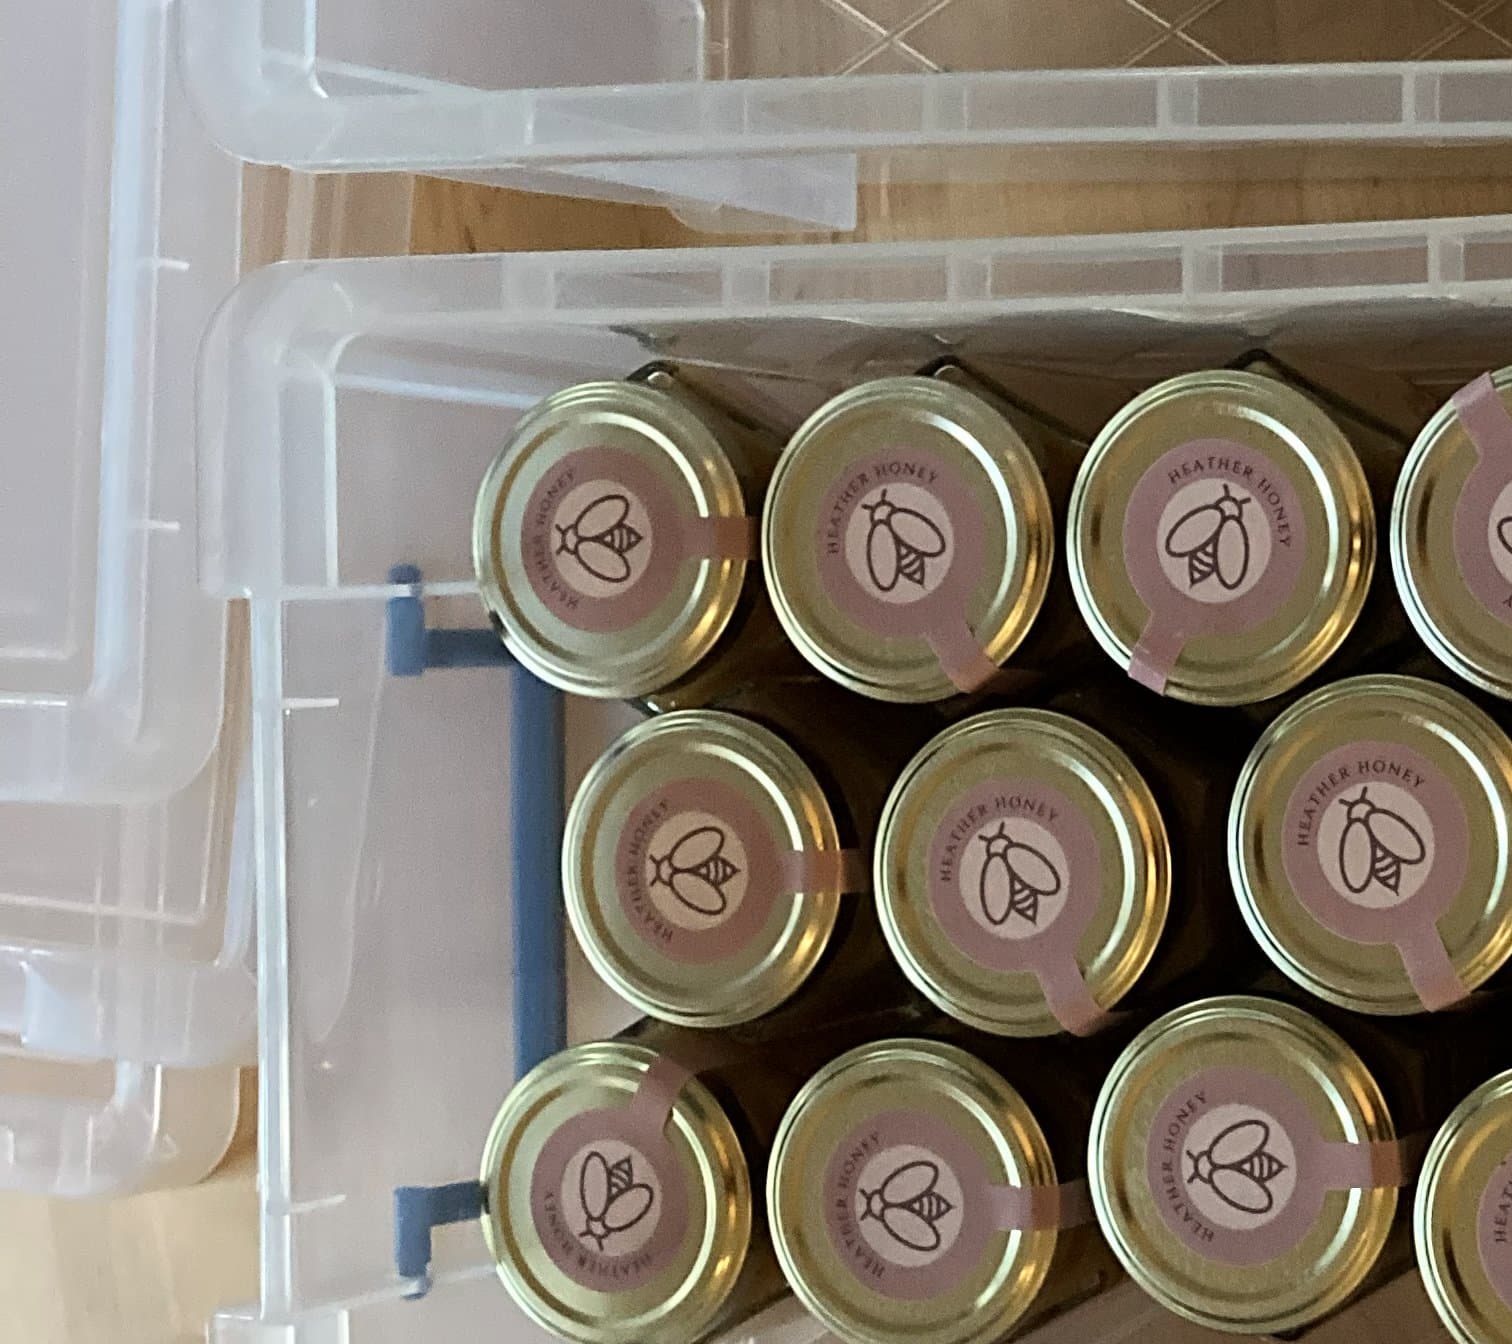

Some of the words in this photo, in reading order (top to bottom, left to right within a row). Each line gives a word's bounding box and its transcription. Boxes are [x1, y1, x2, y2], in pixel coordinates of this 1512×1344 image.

[826, 474, 870, 554] HEATHER
[875, 460, 938, 485] HONEY
[1169, 457, 1254, 484] HEATHER
[1257, 478, 1292, 548] HONEY
[940, 805, 988, 883] HEATHER
[993, 795, 1060, 824] HONEY
[1296, 766, 1351, 847] HEATHER
[1358, 759, 1425, 789] HONEY
[1162, 1090, 1208, 1151] HONEY
[1161, 1159, 1215, 1243] HEATHER
